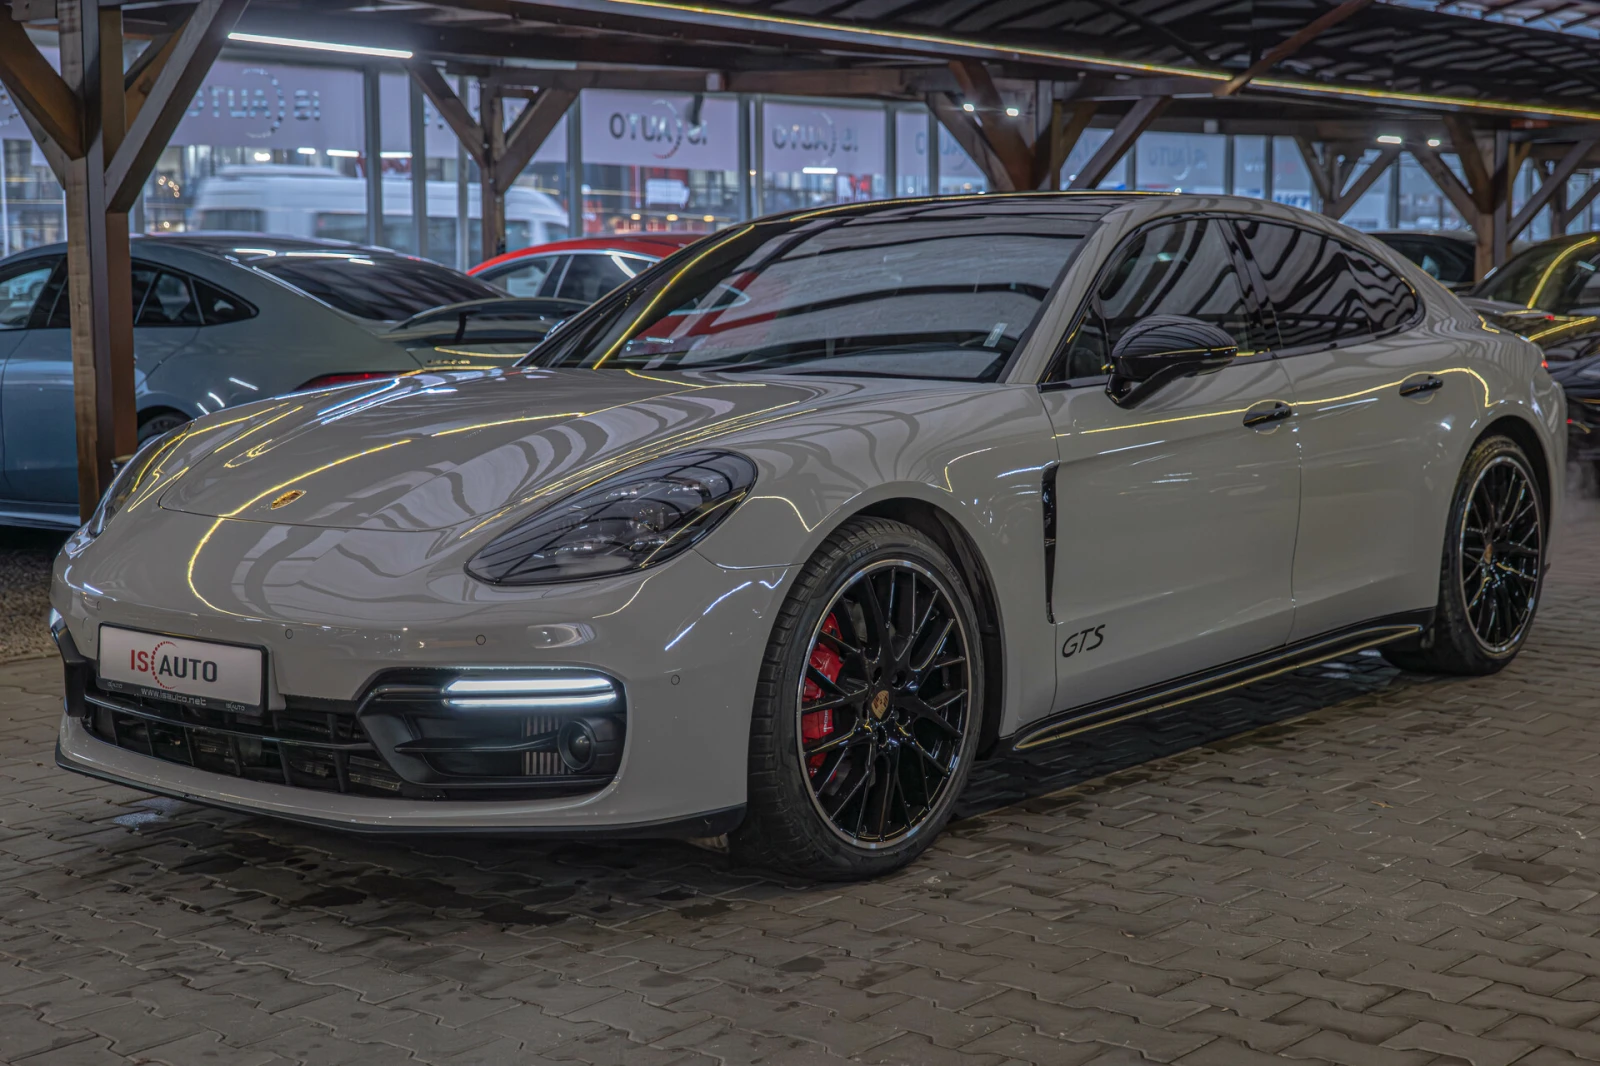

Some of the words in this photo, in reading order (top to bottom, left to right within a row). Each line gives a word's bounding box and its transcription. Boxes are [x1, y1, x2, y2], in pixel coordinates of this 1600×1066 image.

[1062, 624, 1106, 658] GTS
[130, 649, 149, 672] IS
[158, 654, 218, 682] AUTO
[140, 687, 207, 706] www.isauto.net
